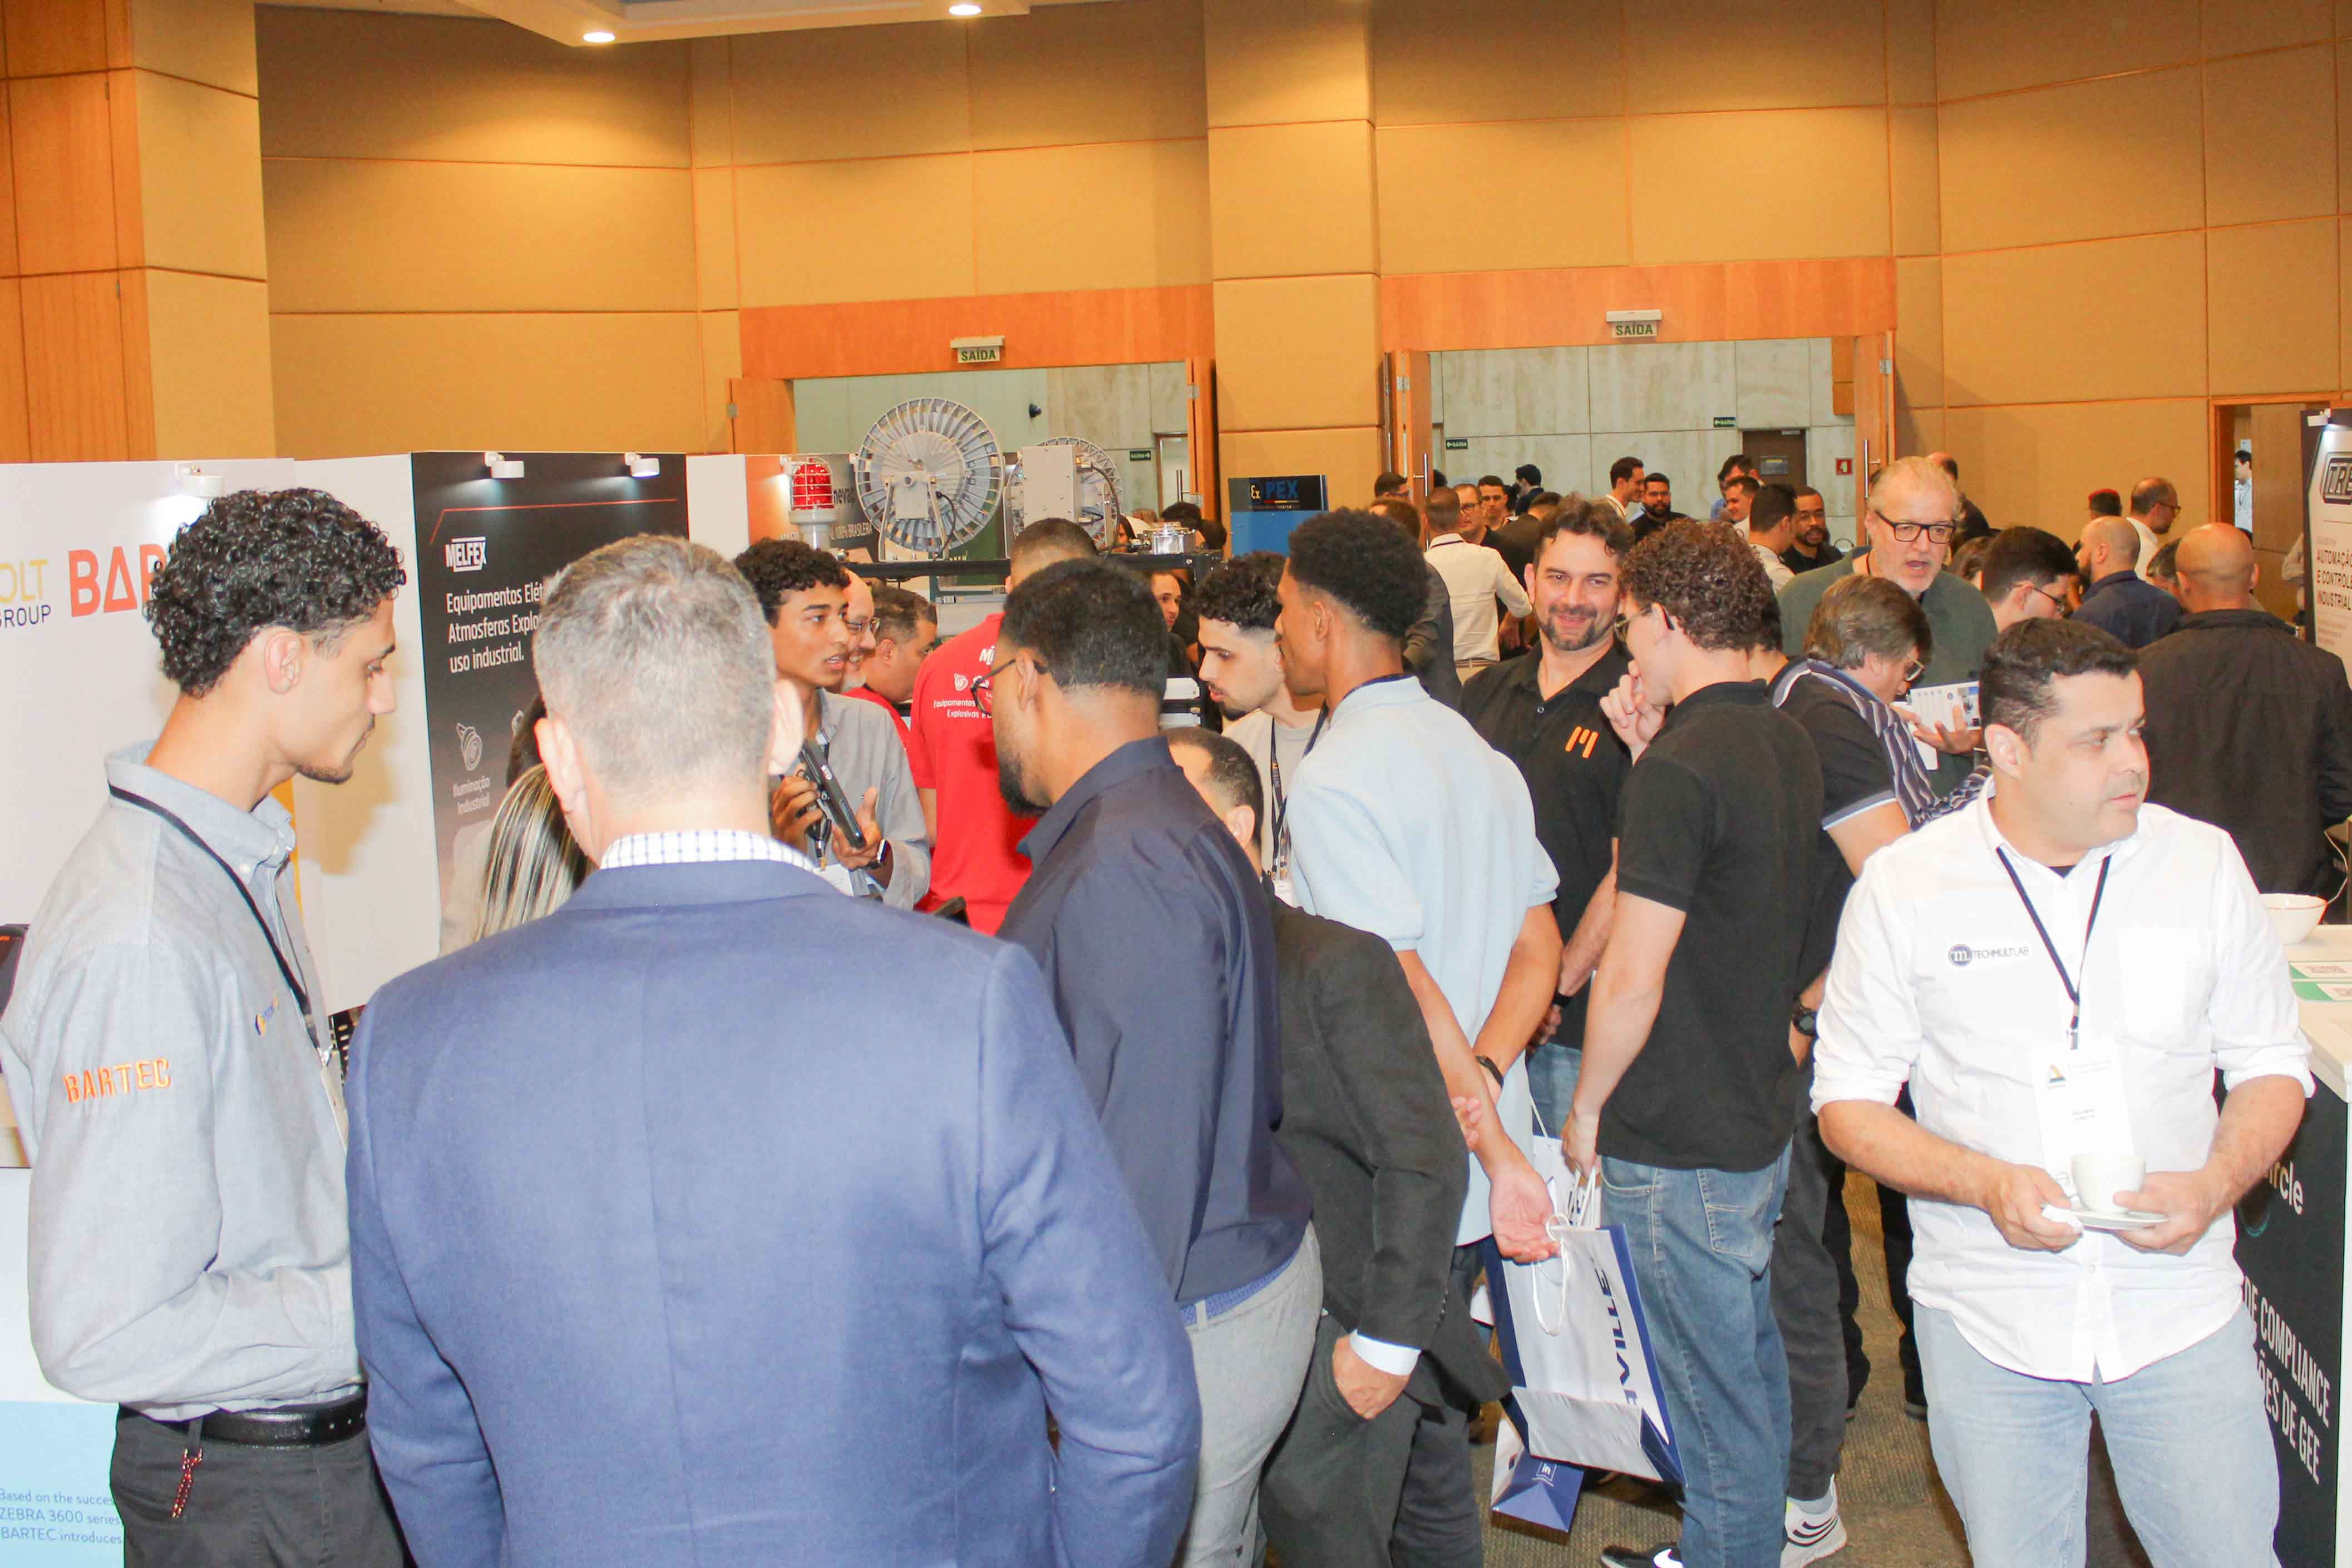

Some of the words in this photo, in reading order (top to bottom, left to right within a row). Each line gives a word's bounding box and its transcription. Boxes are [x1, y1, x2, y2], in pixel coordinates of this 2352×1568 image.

[1265, 480, 1299, 499] PEX
[446, 586, 522, 615] Equipamentos
[2318, 591, 2351, 610] INDUSTRIAL
[0, 605, 51, 628] ROUP
[448, 617, 510, 643] Atmosferas
[450, 655, 470, 673] uso
[472, 641, 524, 669] industrial.
[934, 699, 976, 708] Equipamentos
[947, 709, 979, 718] Explosivos
[62, 1058, 171, 1104] BARTEC
[2260, 1297, 2330, 1428] COMPLIANCE
[2282, 1390, 2297, 1448] DE
[2299, 1416, 2320, 1485] GEE
[36, 1493, 50, 1502] on
[53, 1491, 73, 1503] the
[0, 1507, 45, 1521] ZEBRA
[48, 1510, 83, 1523] 3600
[2, 1526, 57, 1541] BARTEC
[61, 1528, 122, 1545] introduces
